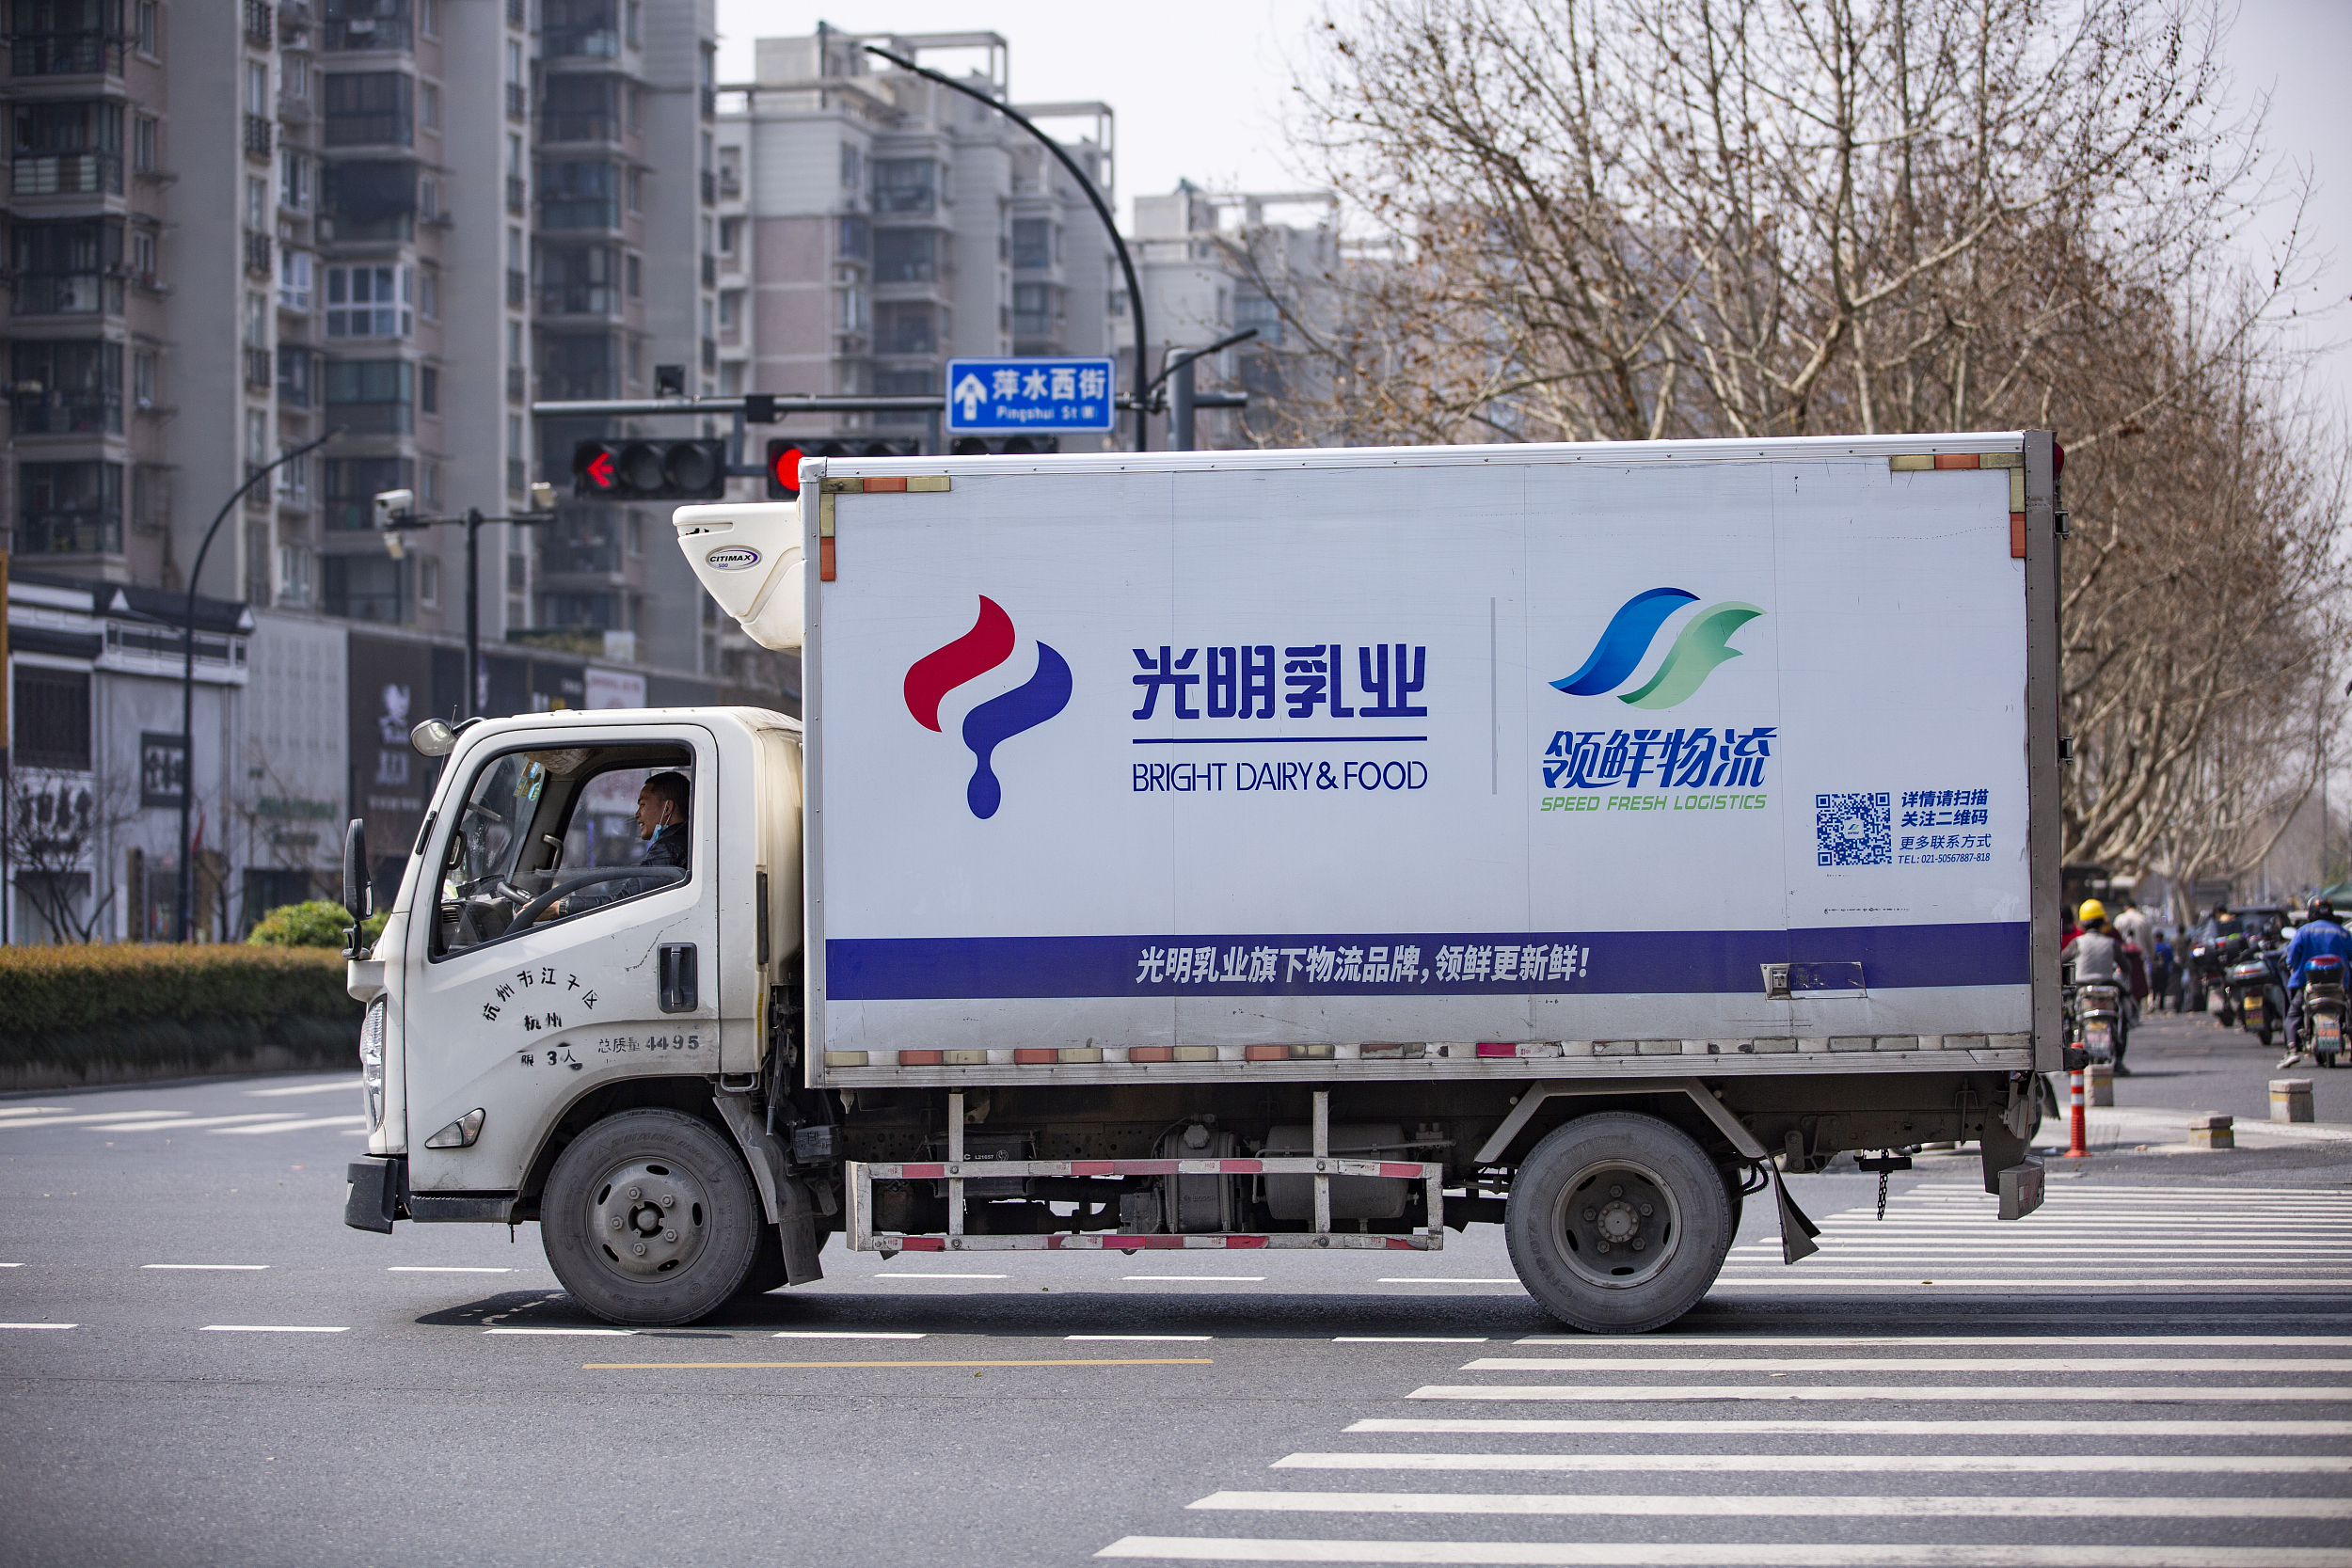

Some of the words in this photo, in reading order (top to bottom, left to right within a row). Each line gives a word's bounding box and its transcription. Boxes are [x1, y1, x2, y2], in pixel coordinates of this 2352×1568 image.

[993, 368, 1106, 402] 萍水西街
[996, 404, 1056, 423] Pingshui
[709, 553, 752, 563] CITIMAX
[1132, 642, 1428, 721] 光明乳业
[1542, 726, 1778, 789] 领鲜物流
[1132, 762, 1228, 792] BRIGHT
[1540, 796, 1600, 812] SPEED
[1607, 795, 1668, 811] FRESH
[1674, 794, 1768, 811] LOGISTICS
[1901, 788, 1989, 808] 详情请扫描
[1900, 808, 1989, 828] 关注二维码
[1899, 833, 1993, 851] 更多联系方式
[523, 1012, 563, 1031] 杭州
